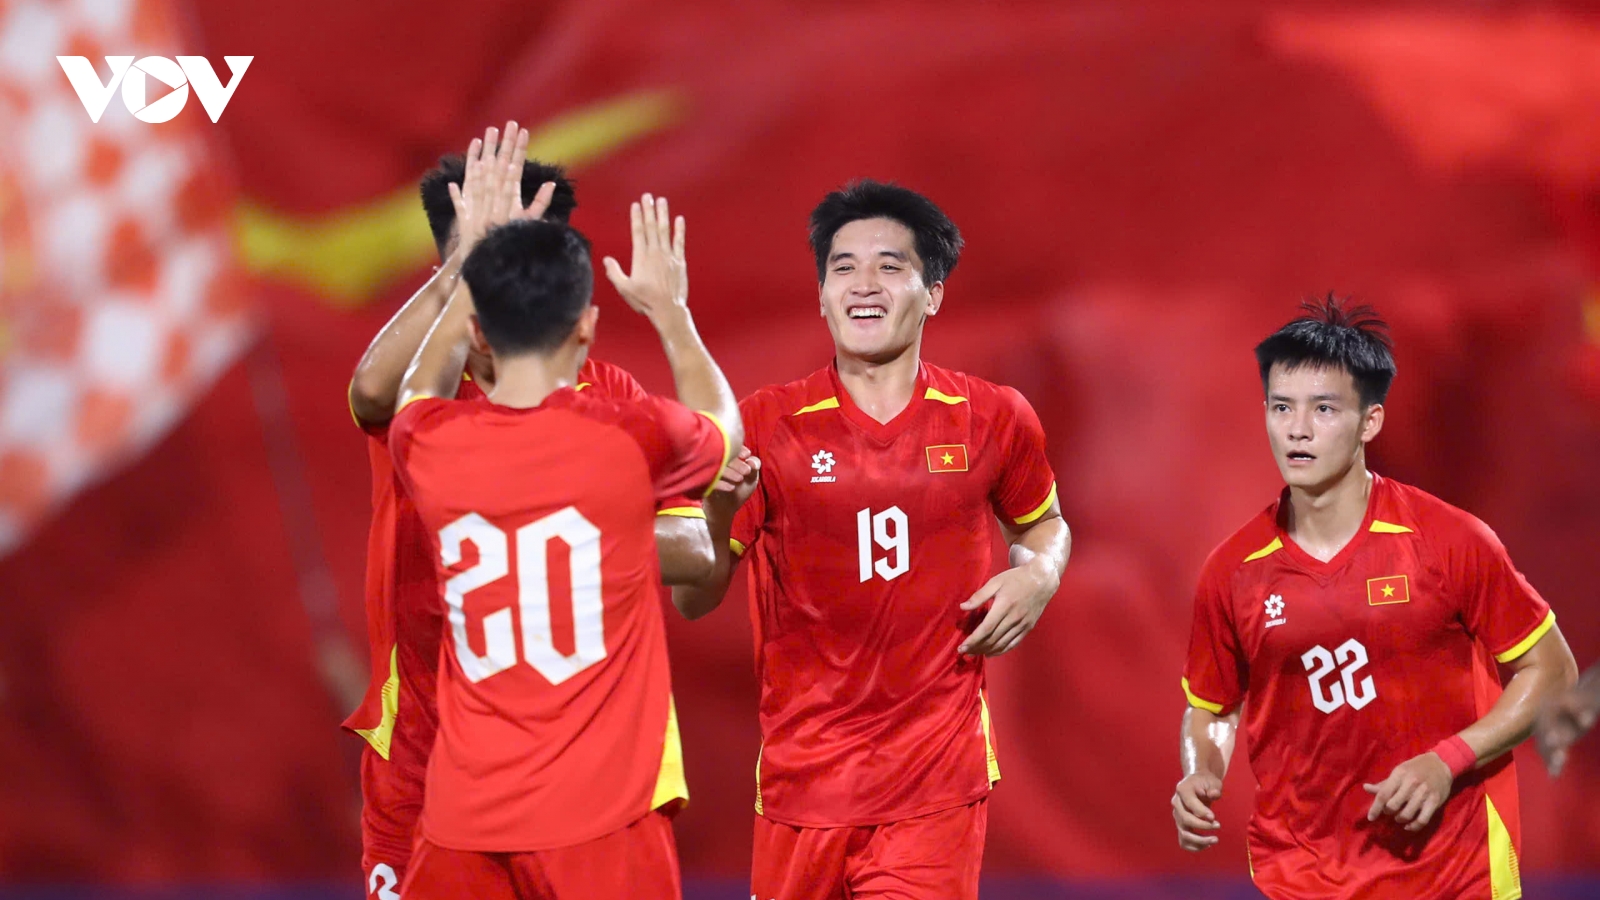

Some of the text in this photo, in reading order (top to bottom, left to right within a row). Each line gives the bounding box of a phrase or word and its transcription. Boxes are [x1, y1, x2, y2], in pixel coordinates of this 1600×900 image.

[857, 506, 910, 583] 19
[439, 506, 607, 686] 20
[1301, 638, 1377, 714] 22
